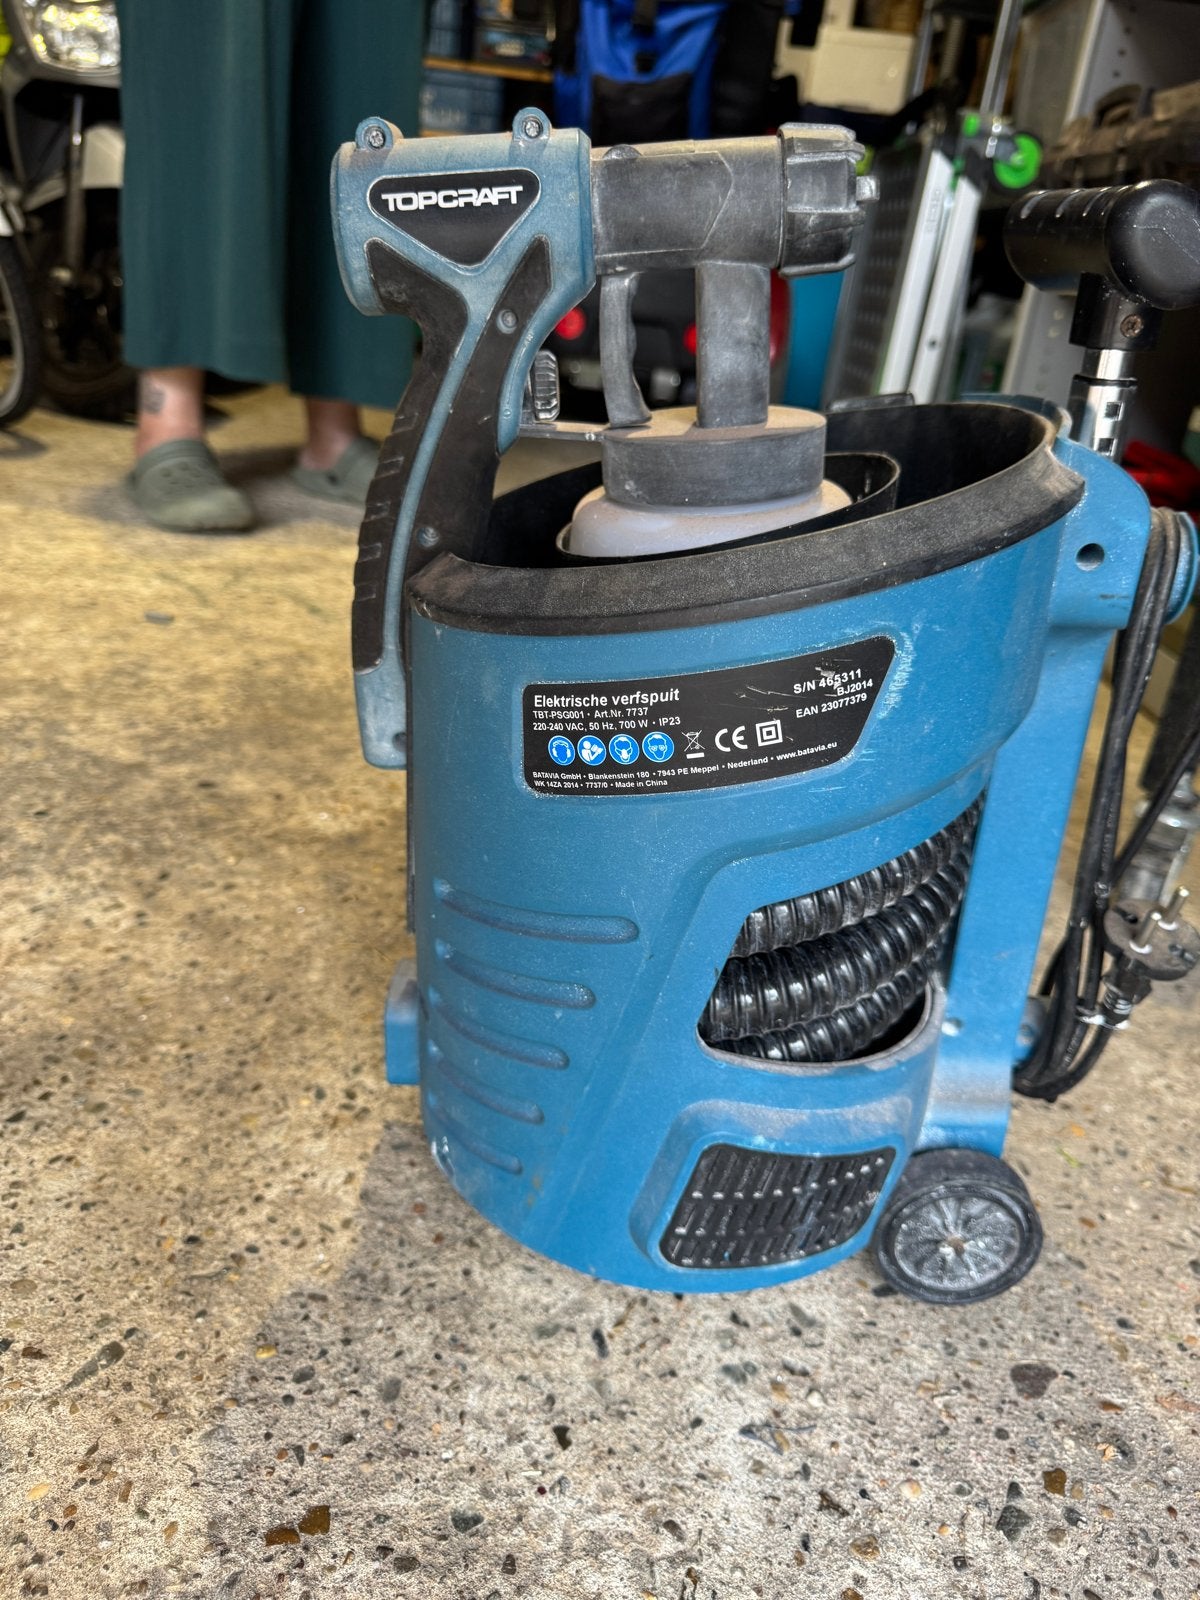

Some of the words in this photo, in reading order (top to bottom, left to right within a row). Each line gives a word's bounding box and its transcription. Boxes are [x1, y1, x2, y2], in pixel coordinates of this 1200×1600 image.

[381, 185, 523, 211] TOPCRAFT
[793, 680, 816, 694] S/N
[819, 668, 861, 688] 465311
[837, 678, 873, 696] BJ2014
[534, 694, 608, 708] Elektrische
[611, 688, 680, 706] verfspuit
[795, 705, 819, 718] EAN
[821, 692, 867, 712] 23077379
[532, 710, 585, 719] TBT-PSG001
[594, 709, 624, 719] Art.Nr.
[626, 707, 649, 717] 7737
[532, 722, 564, 731] 220-240
[565, 722, 587, 732] VAC,
[589, 722, 600, 731] 50
[619, 720, 636, 729] 700
[638, 719, 648, 728] W
[659, 716, 681, 726] IP23
[714, 726, 748, 752] CE
[532, 771, 560, 779] BATAVIA
[588, 771, 635, 780] Blankenstein
[636, 771, 650, 779] 180
[657, 769, 676, 777] 7943
[691, 764, 719, 774] Meppel
[727, 756, 768, 770] Nederland
[776, 741, 837, 761] www.batavia.eu
[547, 780, 562, 788] 14ZA
[563, 781, 579, 789] 2014
[585, 781, 609, 789] 7737/0
[615, 780, 635, 788] Made
[645, 779, 668, 787] China
